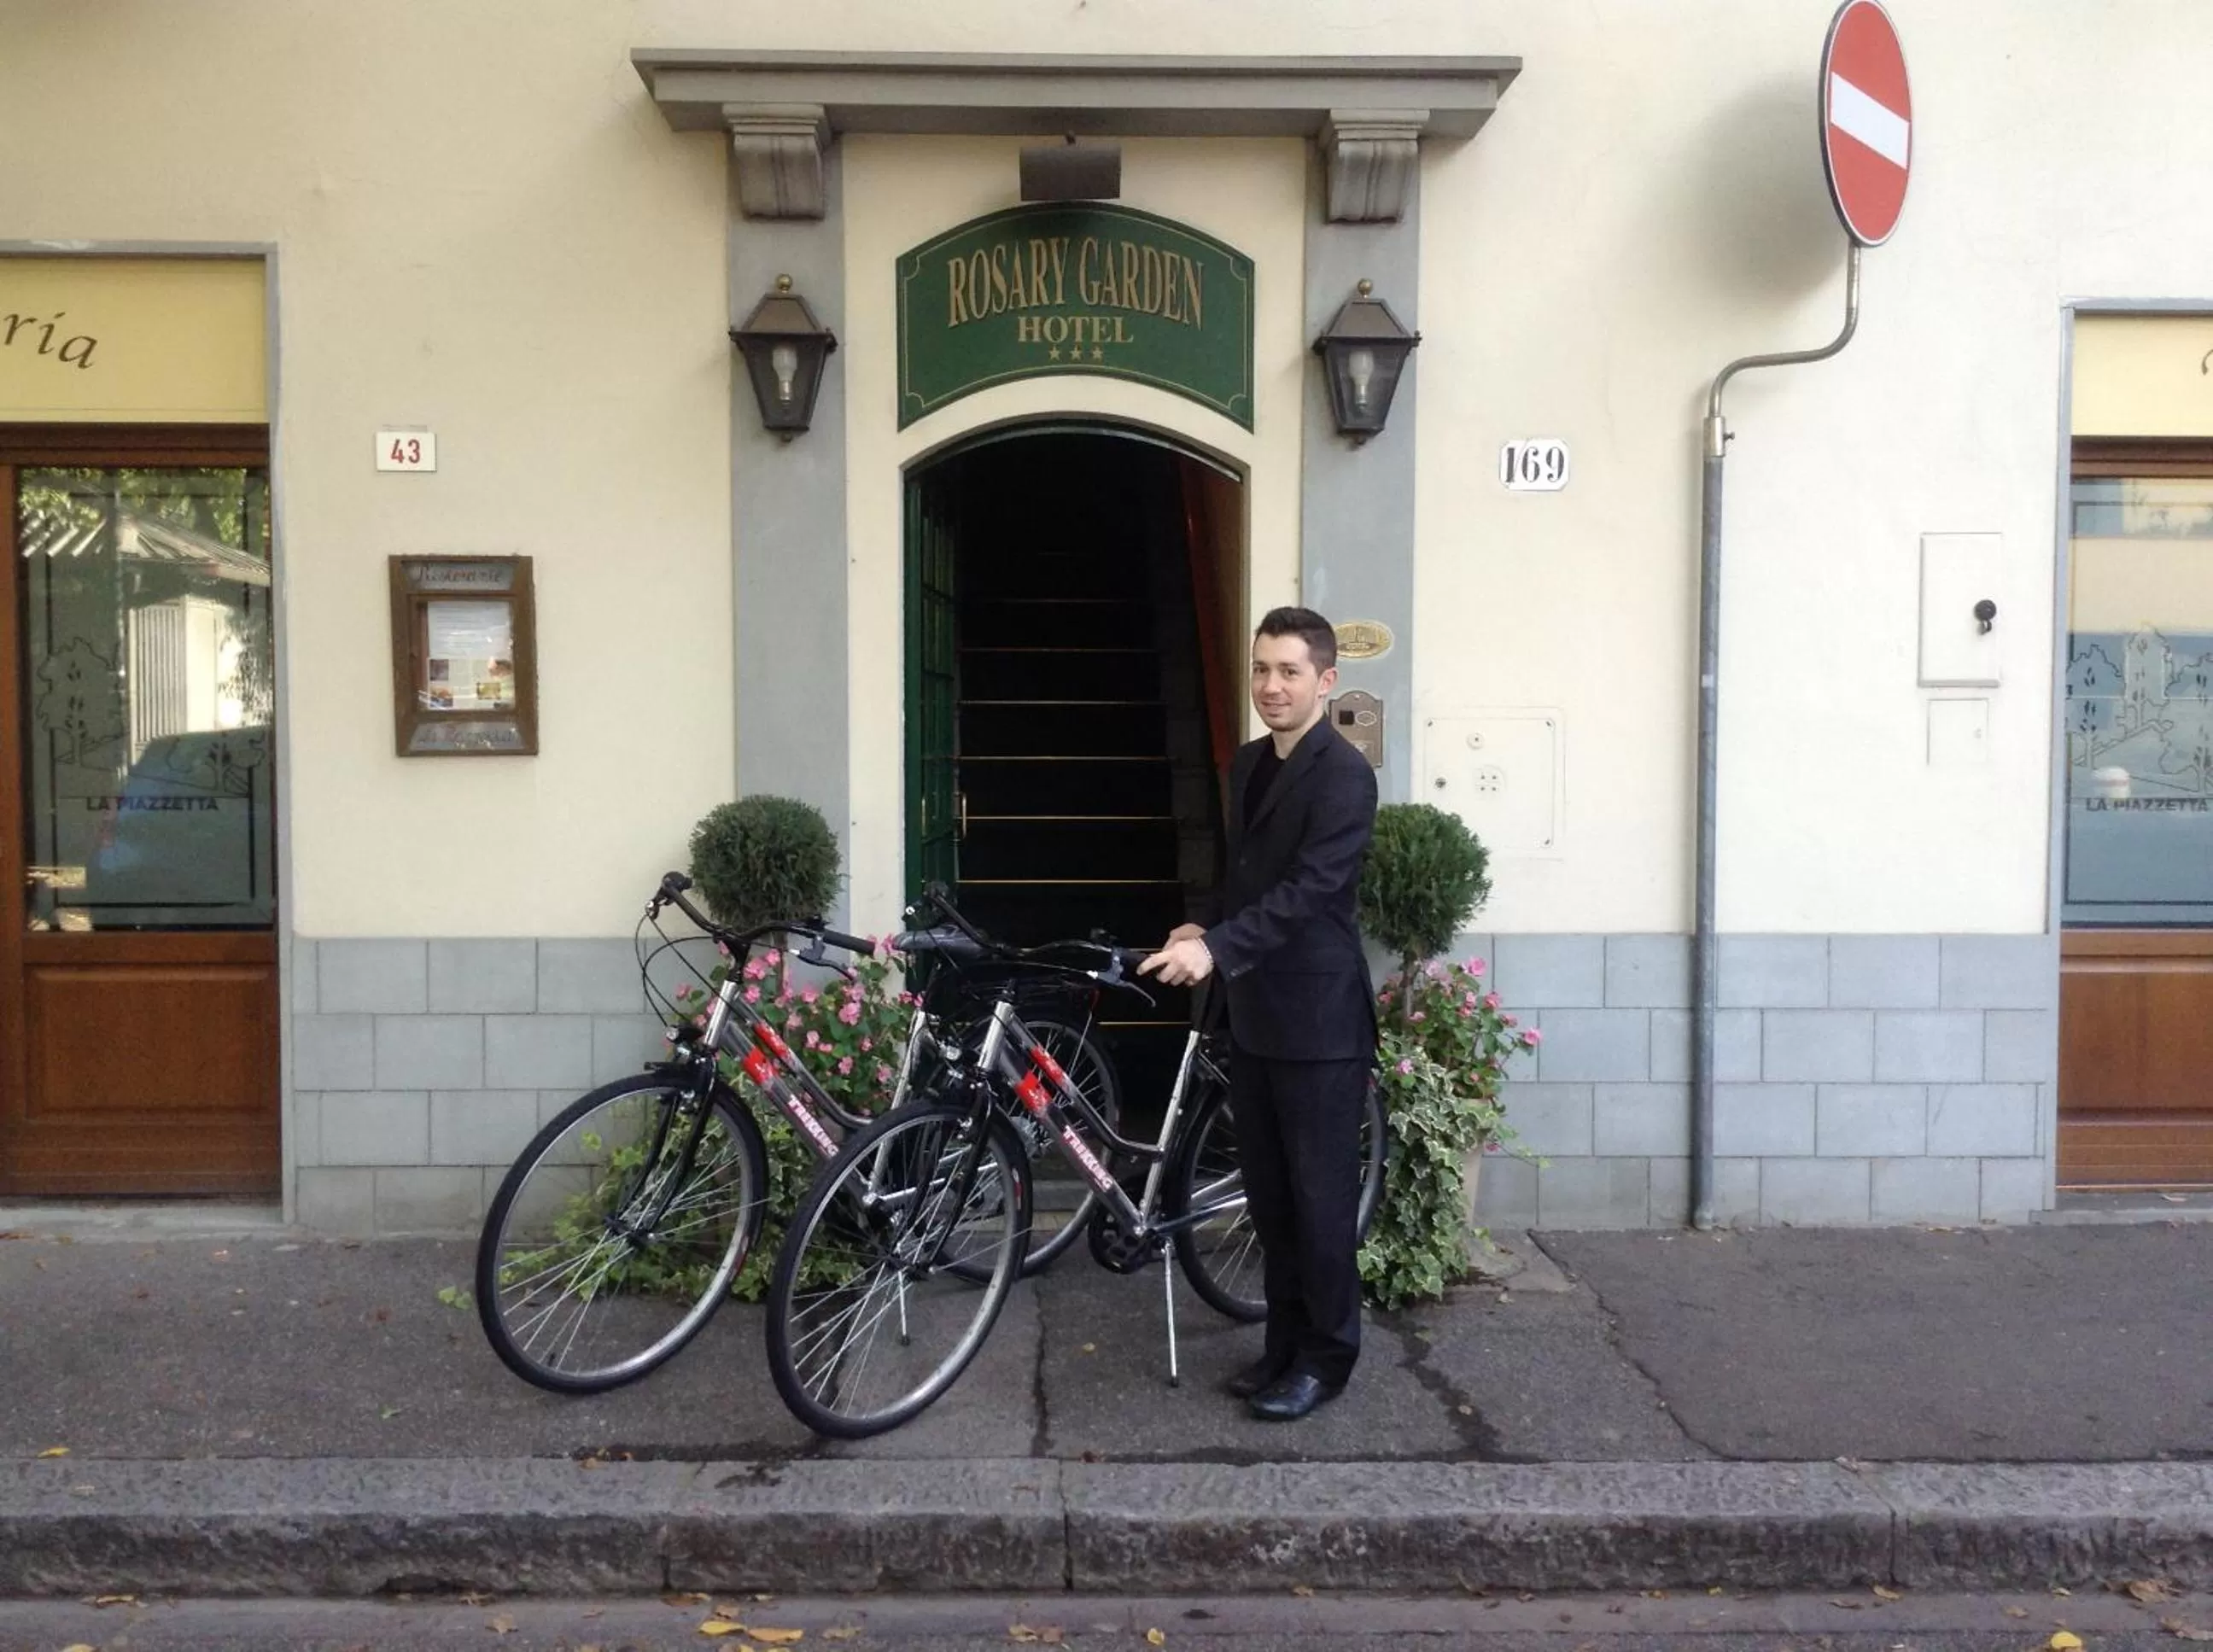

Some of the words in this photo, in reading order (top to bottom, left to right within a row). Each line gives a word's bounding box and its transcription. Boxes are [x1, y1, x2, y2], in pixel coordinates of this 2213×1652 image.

[947, 236, 1071, 330] ROSARY
[1079, 237, 1204, 331] GARDEN
[1017, 316, 1135, 343] HOTEL
[390, 438, 421, 464] 43
[1504, 447, 1565, 483] 169
[86, 796, 109, 811] LA
[116, 795, 219, 811] PIAZZETTA
[2085, 797, 2108, 812] LA
[2113, 797, 2209, 812] PIAZZETTA
[787, 1093, 840, 1157] TREKKING
[1062, 1124, 1113, 1189] TREKKING
